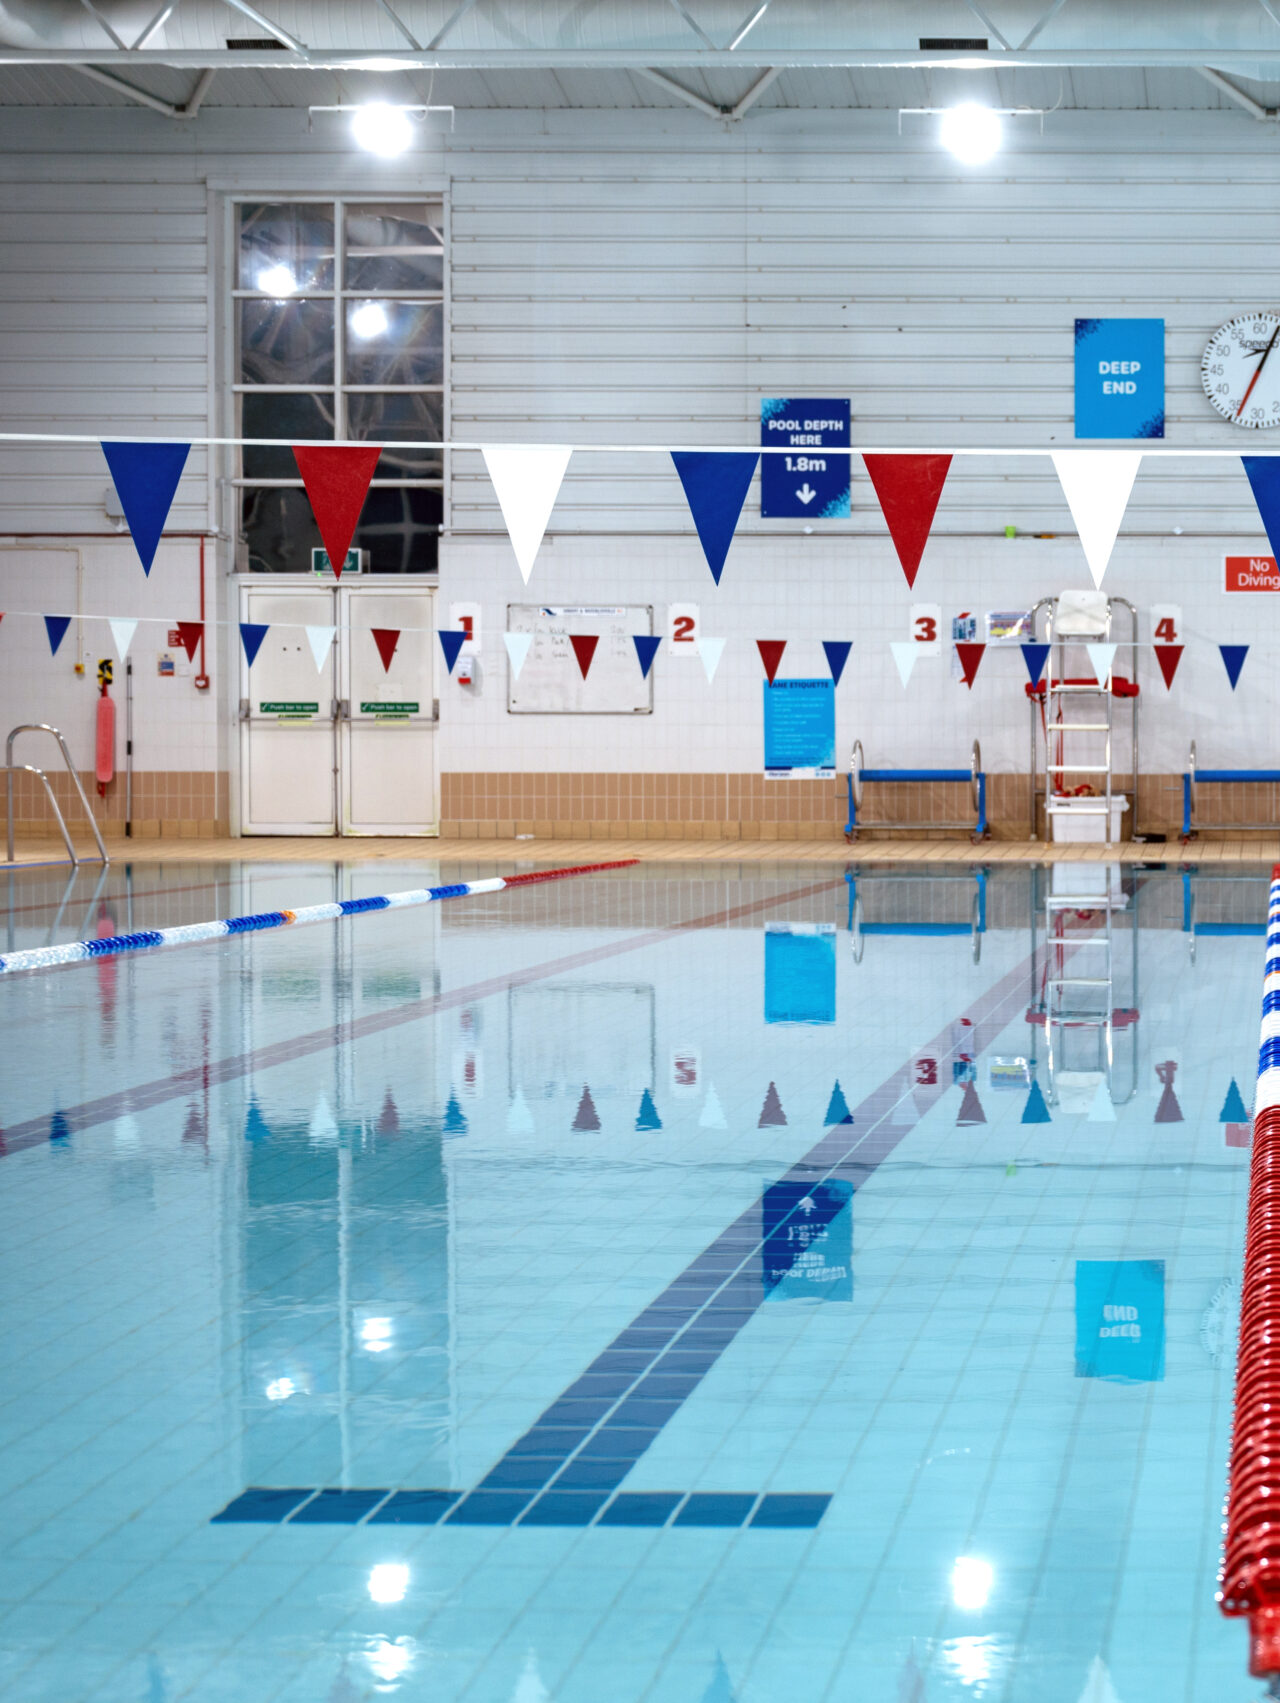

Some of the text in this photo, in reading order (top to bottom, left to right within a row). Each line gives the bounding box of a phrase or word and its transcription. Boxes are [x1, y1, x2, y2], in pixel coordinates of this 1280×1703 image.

[1230, 328, 1245, 340] 55
[1253, 322, 1268, 335] 60
[1216, 345, 1231, 357] 50
[1098, 361, 1142, 375] DEEP
[1210, 364, 1224, 376] 45
[1102, 381, 1137, 395] END
[1215, 383, 1230, 395] 40
[1251, 408, 1265, 420] 30
[768, 420, 844, 431] POOL DEPTH
[790, 434, 823, 445] HERE
[785, 456, 827, 472] 1.8m
[1249, 559, 1270, 573] No
[1237, 572, 1280, 590] Diving
[458, 616, 474, 641] 1
[673, 616, 696, 642] 2
[914, 617, 937, 642] 3
[1154, 618, 1178, 643] 4
